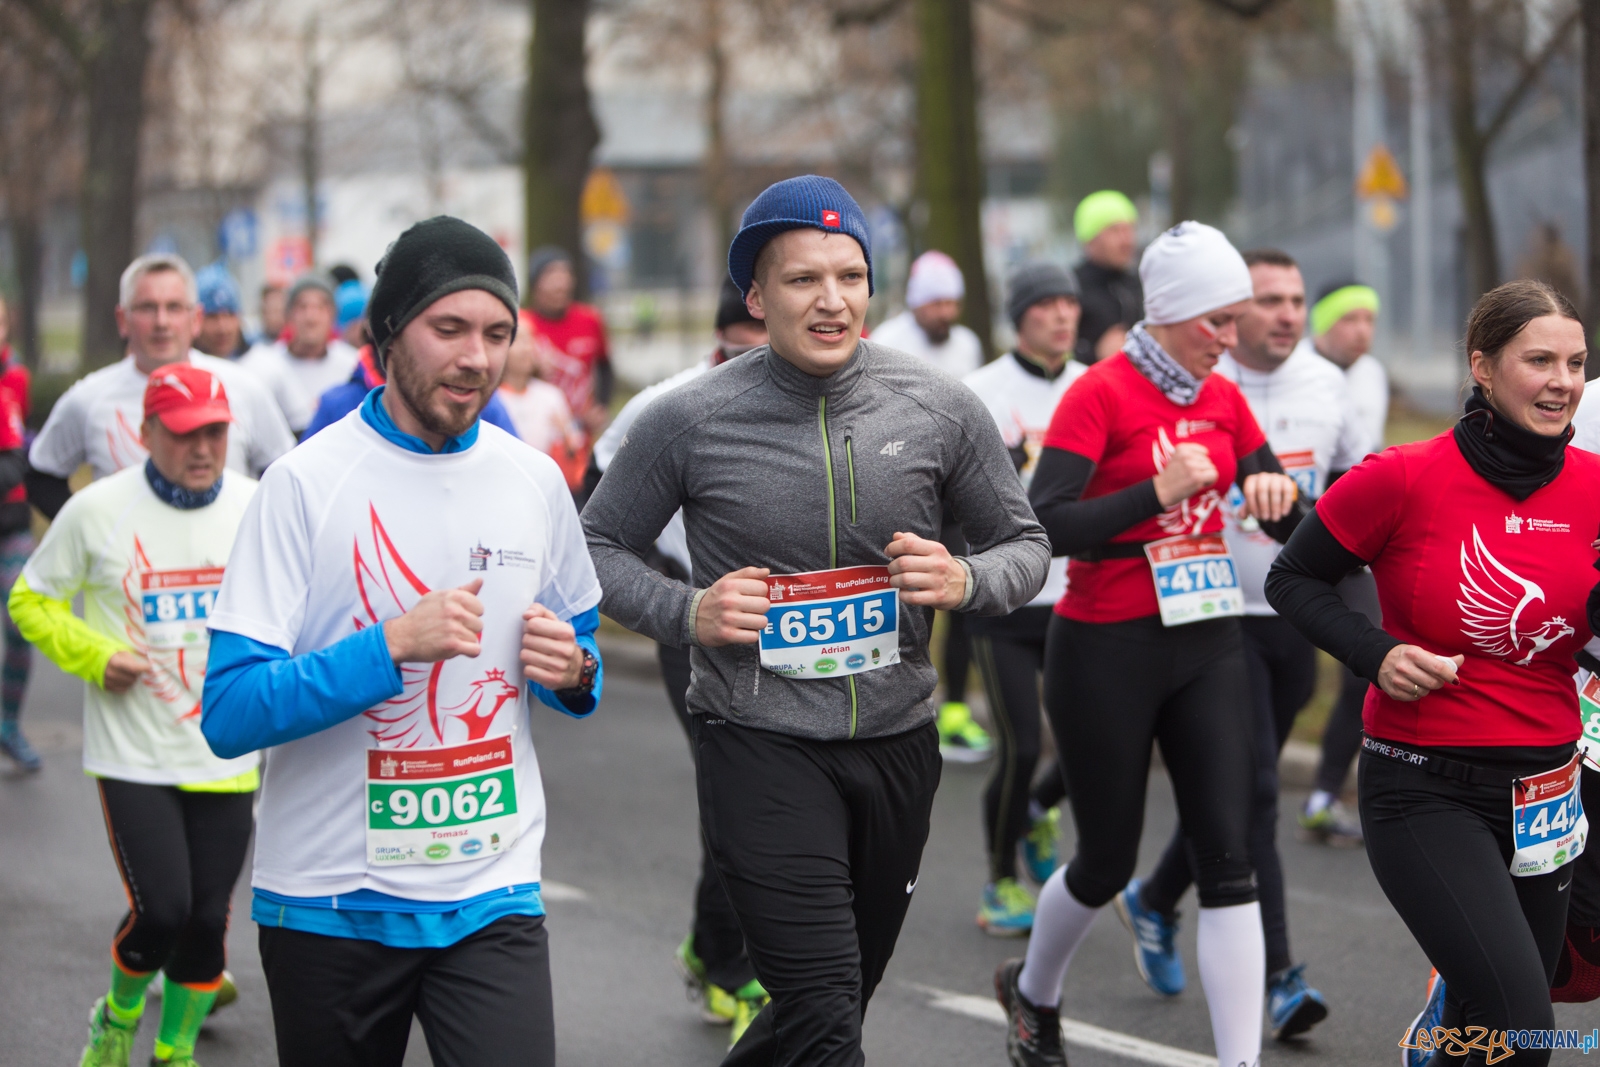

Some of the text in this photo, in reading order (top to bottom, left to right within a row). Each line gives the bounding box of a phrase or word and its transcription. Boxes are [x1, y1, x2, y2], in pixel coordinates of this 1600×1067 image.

[880, 441, 905, 456] 4F
[835, 575, 889, 589] RunPoland.org
[1171, 560, 1233, 592] 4708
[764, 599, 885, 644] E 6515
[821, 645, 851, 655] Adrian
[453, 750, 506, 768] RunPoland.org
[371, 777, 504, 826] C 9062
[430, 829, 468, 839] Tomasz
[1517, 823, 1526, 834] E
[1517, 865, 1542, 873] LUXMED
[1518, 860, 1539, 868] GRUPA
